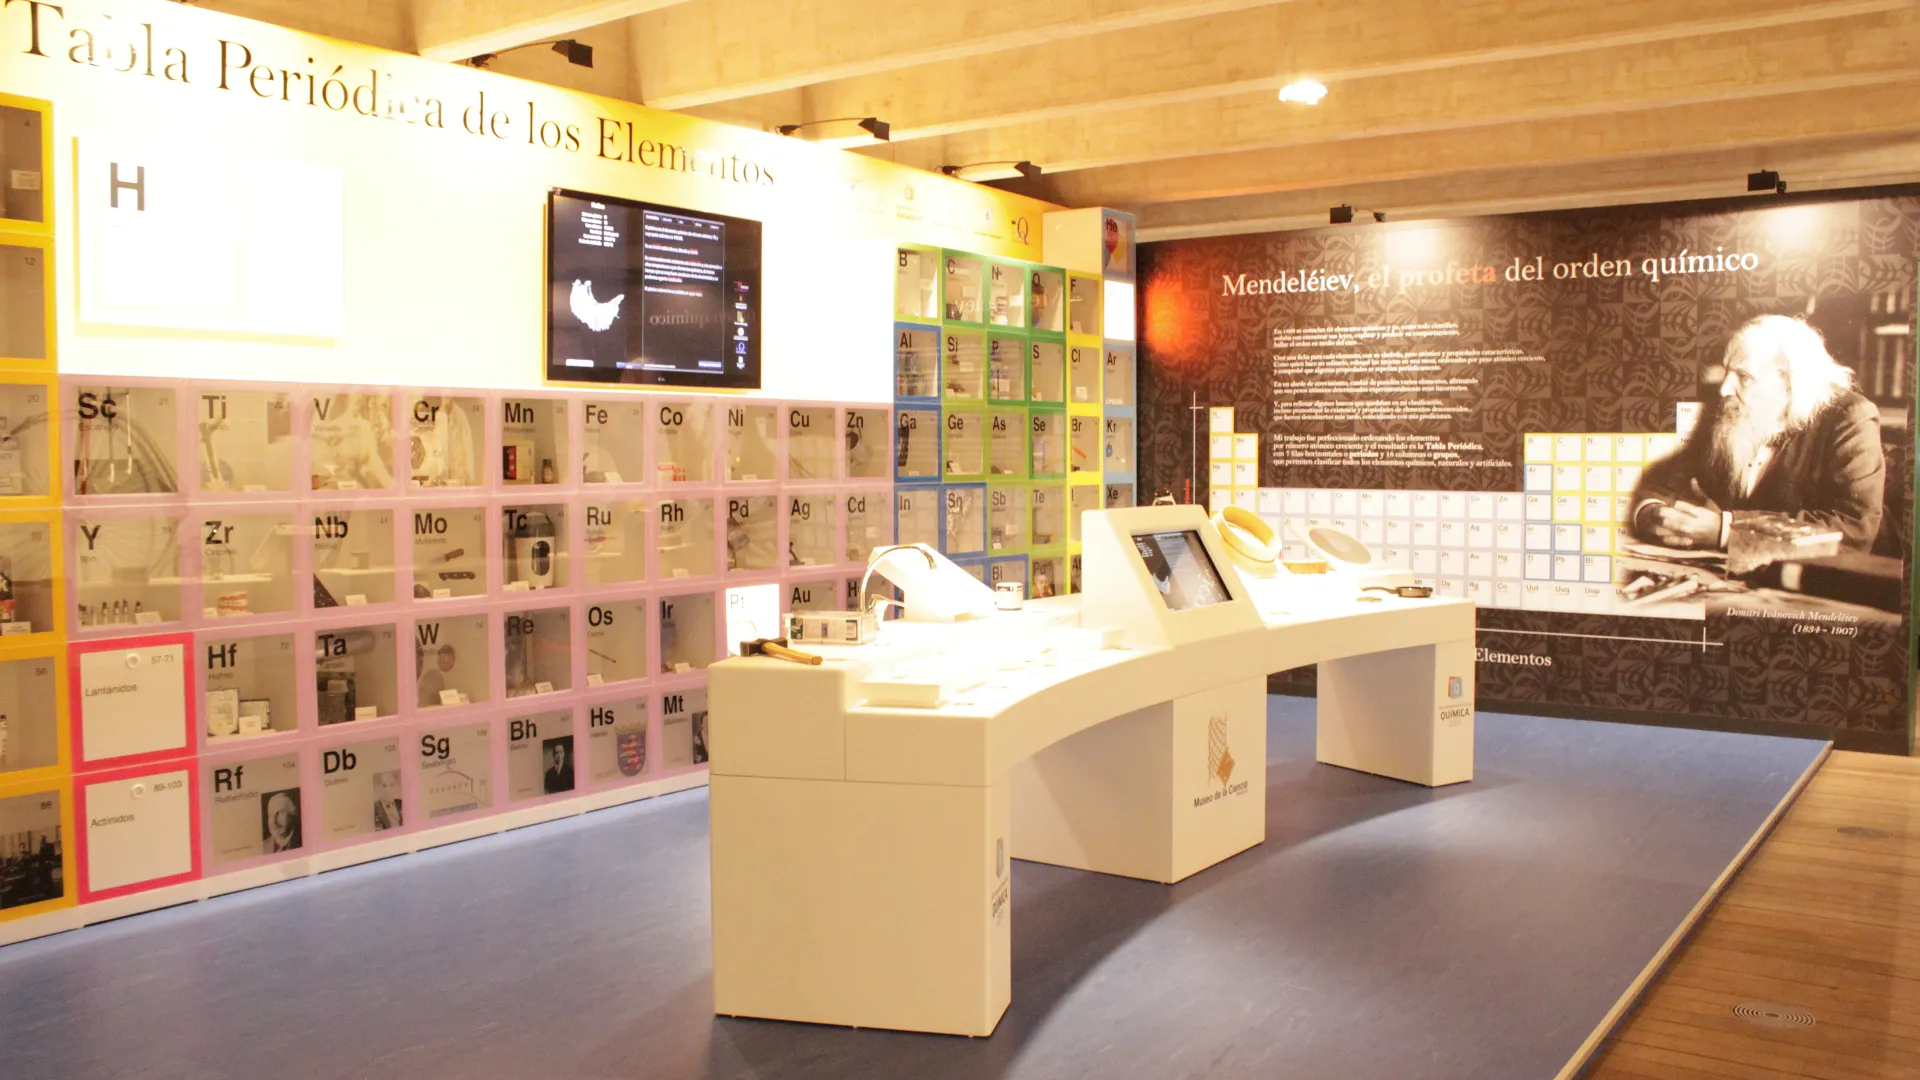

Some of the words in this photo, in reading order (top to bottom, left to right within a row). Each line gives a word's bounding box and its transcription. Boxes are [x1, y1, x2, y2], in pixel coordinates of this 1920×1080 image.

[463, 91, 510, 140] de
[527, 101, 580, 153] los
[110, 162, 145, 211] H
[899, 250, 908, 267] B
[947, 258, 956, 275] C
[1222, 269, 1360, 297] Mendeléiev,
[1368, 265, 1390, 288] el
[1400, 261, 1496, 295] profeta
[1505, 256, 1544, 282] del
[1553, 252, 1632, 279] orden
[1641, 246, 1759, 282] químico
[1070, 278, 1077, 293] F
[899, 332, 912, 349] Al
[947, 336, 958, 352] Si
[991, 341, 999, 356] P
[1033, 344, 1040, 360] S
[1071, 350, 1081, 363] Cl
[1106, 352, 1117, 366] Ar
[78, 392, 117, 420] Sc
[202, 394, 227, 420] Ti
[313, 398, 331, 421] V
[413, 400, 440, 423] Cr
[504, 402, 535, 424] Mn
[585, 404, 608, 425] Fe
[659, 406, 683, 426] Co
[728, 407, 744, 428] Ni
[790, 409, 810, 429] Cu
[846, 411, 864, 429] Zn
[899, 412, 917, 431] Ga
[947, 414, 964, 431] Ge
[992, 416, 1006, 431] As
[1033, 417, 1046, 432] Se
[1071, 419, 1082, 432] Br
[1106, 419, 1117, 434] Kr
[1284, 434, 1306, 444] trabajo
[1318, 434, 1360, 444] perfeccionado
[1378, 442, 1408, 450] resultado
[1425, 442, 1446, 450] Tabla
[1286, 459, 1313, 467] permiten
[1438, 460, 1469, 468] naturales
[899, 495, 911, 511] In
[948, 491, 963, 510] Sn
[992, 490, 1007, 506] Sb
[1033, 489, 1045, 504] Te
[1106, 486, 1119, 501] Xe
[660, 502, 684, 523] Rh
[728, 499, 749, 519] Pd
[790, 499, 811, 520] Ag
[847, 496, 866, 514] Cd
[414, 512, 448, 535] Mo
[504, 509, 528, 531] Tc
[586, 505, 612, 526] Ru
[80, 525, 101, 550] Y
[205, 521, 235, 545] Zr
[314, 516, 349, 540] Nb
[992, 565, 1003, 582] Bi
[791, 586, 811, 605] Au
[588, 606, 614, 628] Os
[662, 600, 675, 620] Ir
[1726, 606, 1760, 618] Dimitri
[1808, 610, 1859, 622] Mendeléiev
[417, 622, 440, 646] W
[507, 615, 535, 638] Re
[1792, 623, 1822, 635] (1834
[1830, 626, 1858, 638] 1907)
[318, 633, 348, 658] Ta
[207, 642, 237, 670] Hf
[1474, 647, 1552, 667] Elementos
[84, 681, 138, 698] Lantánidos
[663, 694, 684, 716] Mt
[590, 706, 615, 728] Hs
[510, 719, 538, 742] Bh
[420, 734, 451, 760] Sg
[323, 748, 358, 775] Db
[214, 765, 245, 794] Rf
[1194, 794, 1214, 808] Museo
[1214, 790, 1222, 800] de
[1228, 780, 1248, 795] Ciencia
[90, 812, 136, 829] Actínidos
